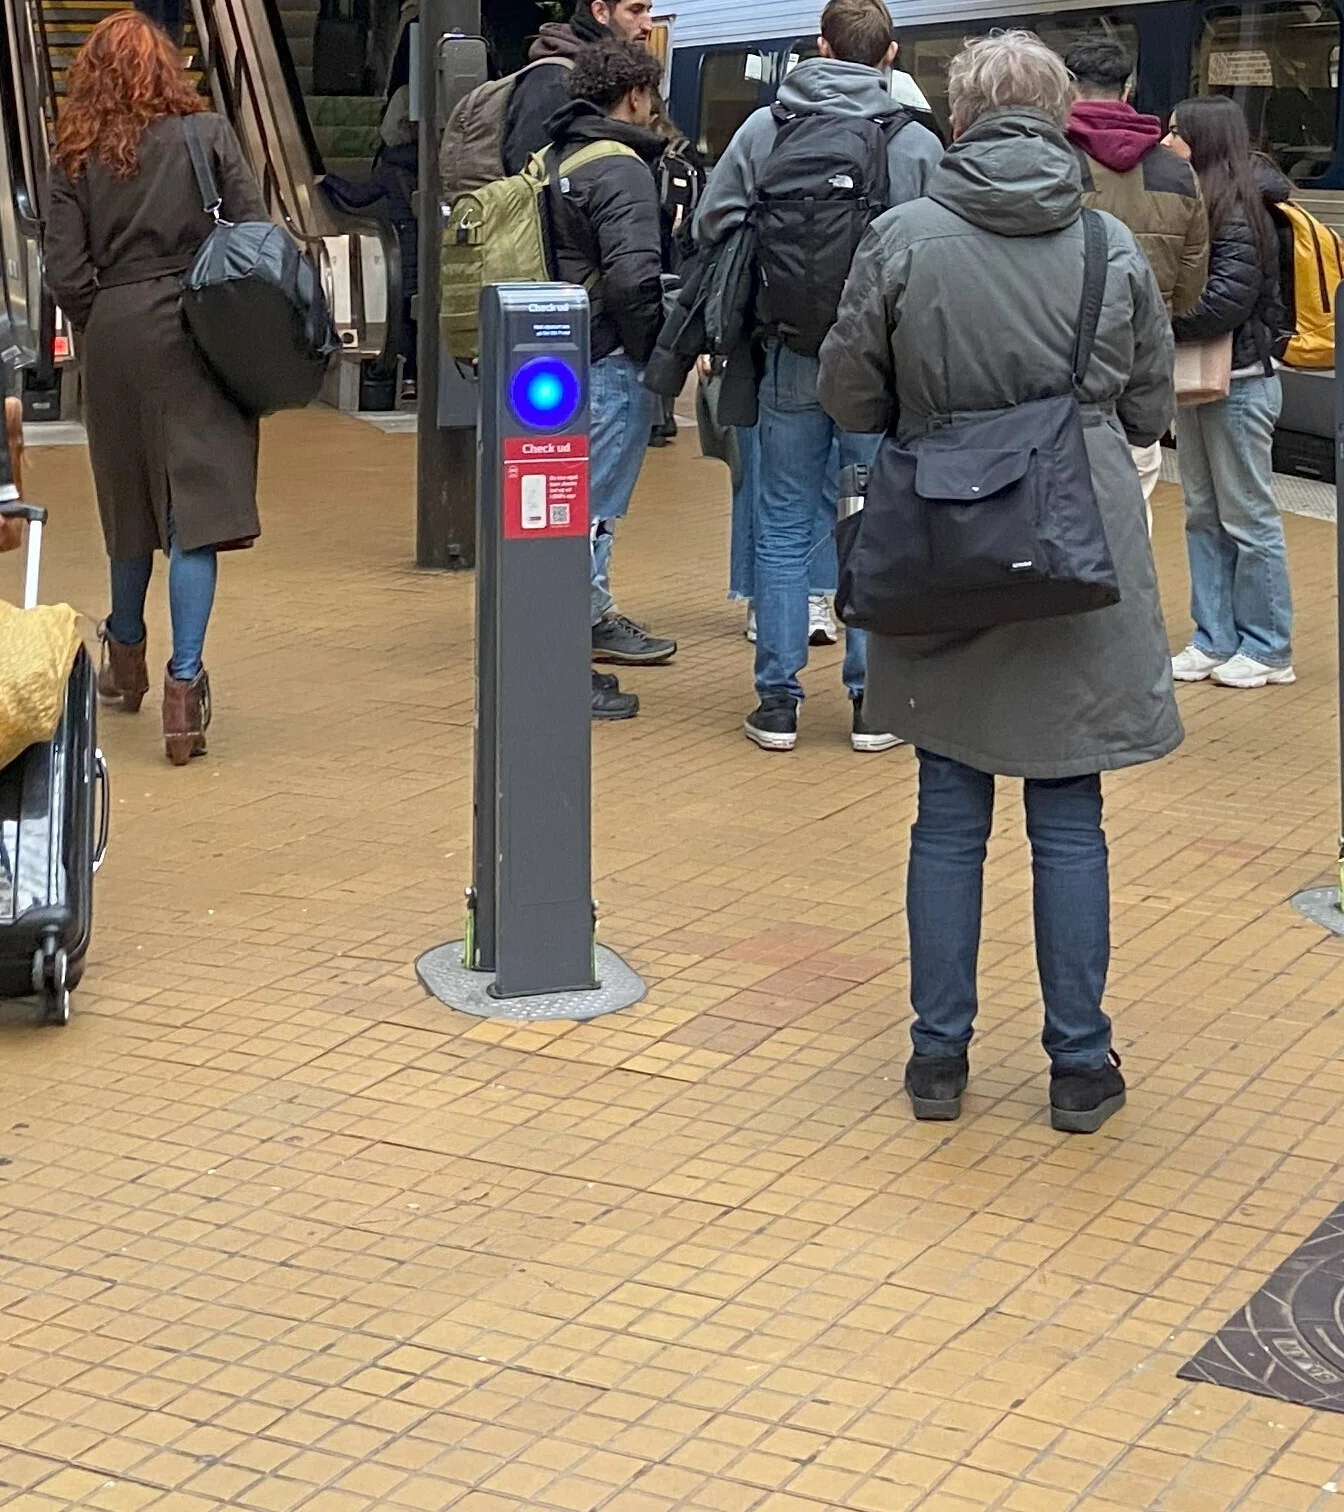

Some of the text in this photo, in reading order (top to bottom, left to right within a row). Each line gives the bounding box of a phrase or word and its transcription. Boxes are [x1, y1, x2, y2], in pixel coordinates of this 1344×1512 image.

[528, 302, 570, 313] Check ud
[522, 442, 571, 455] Check ud
